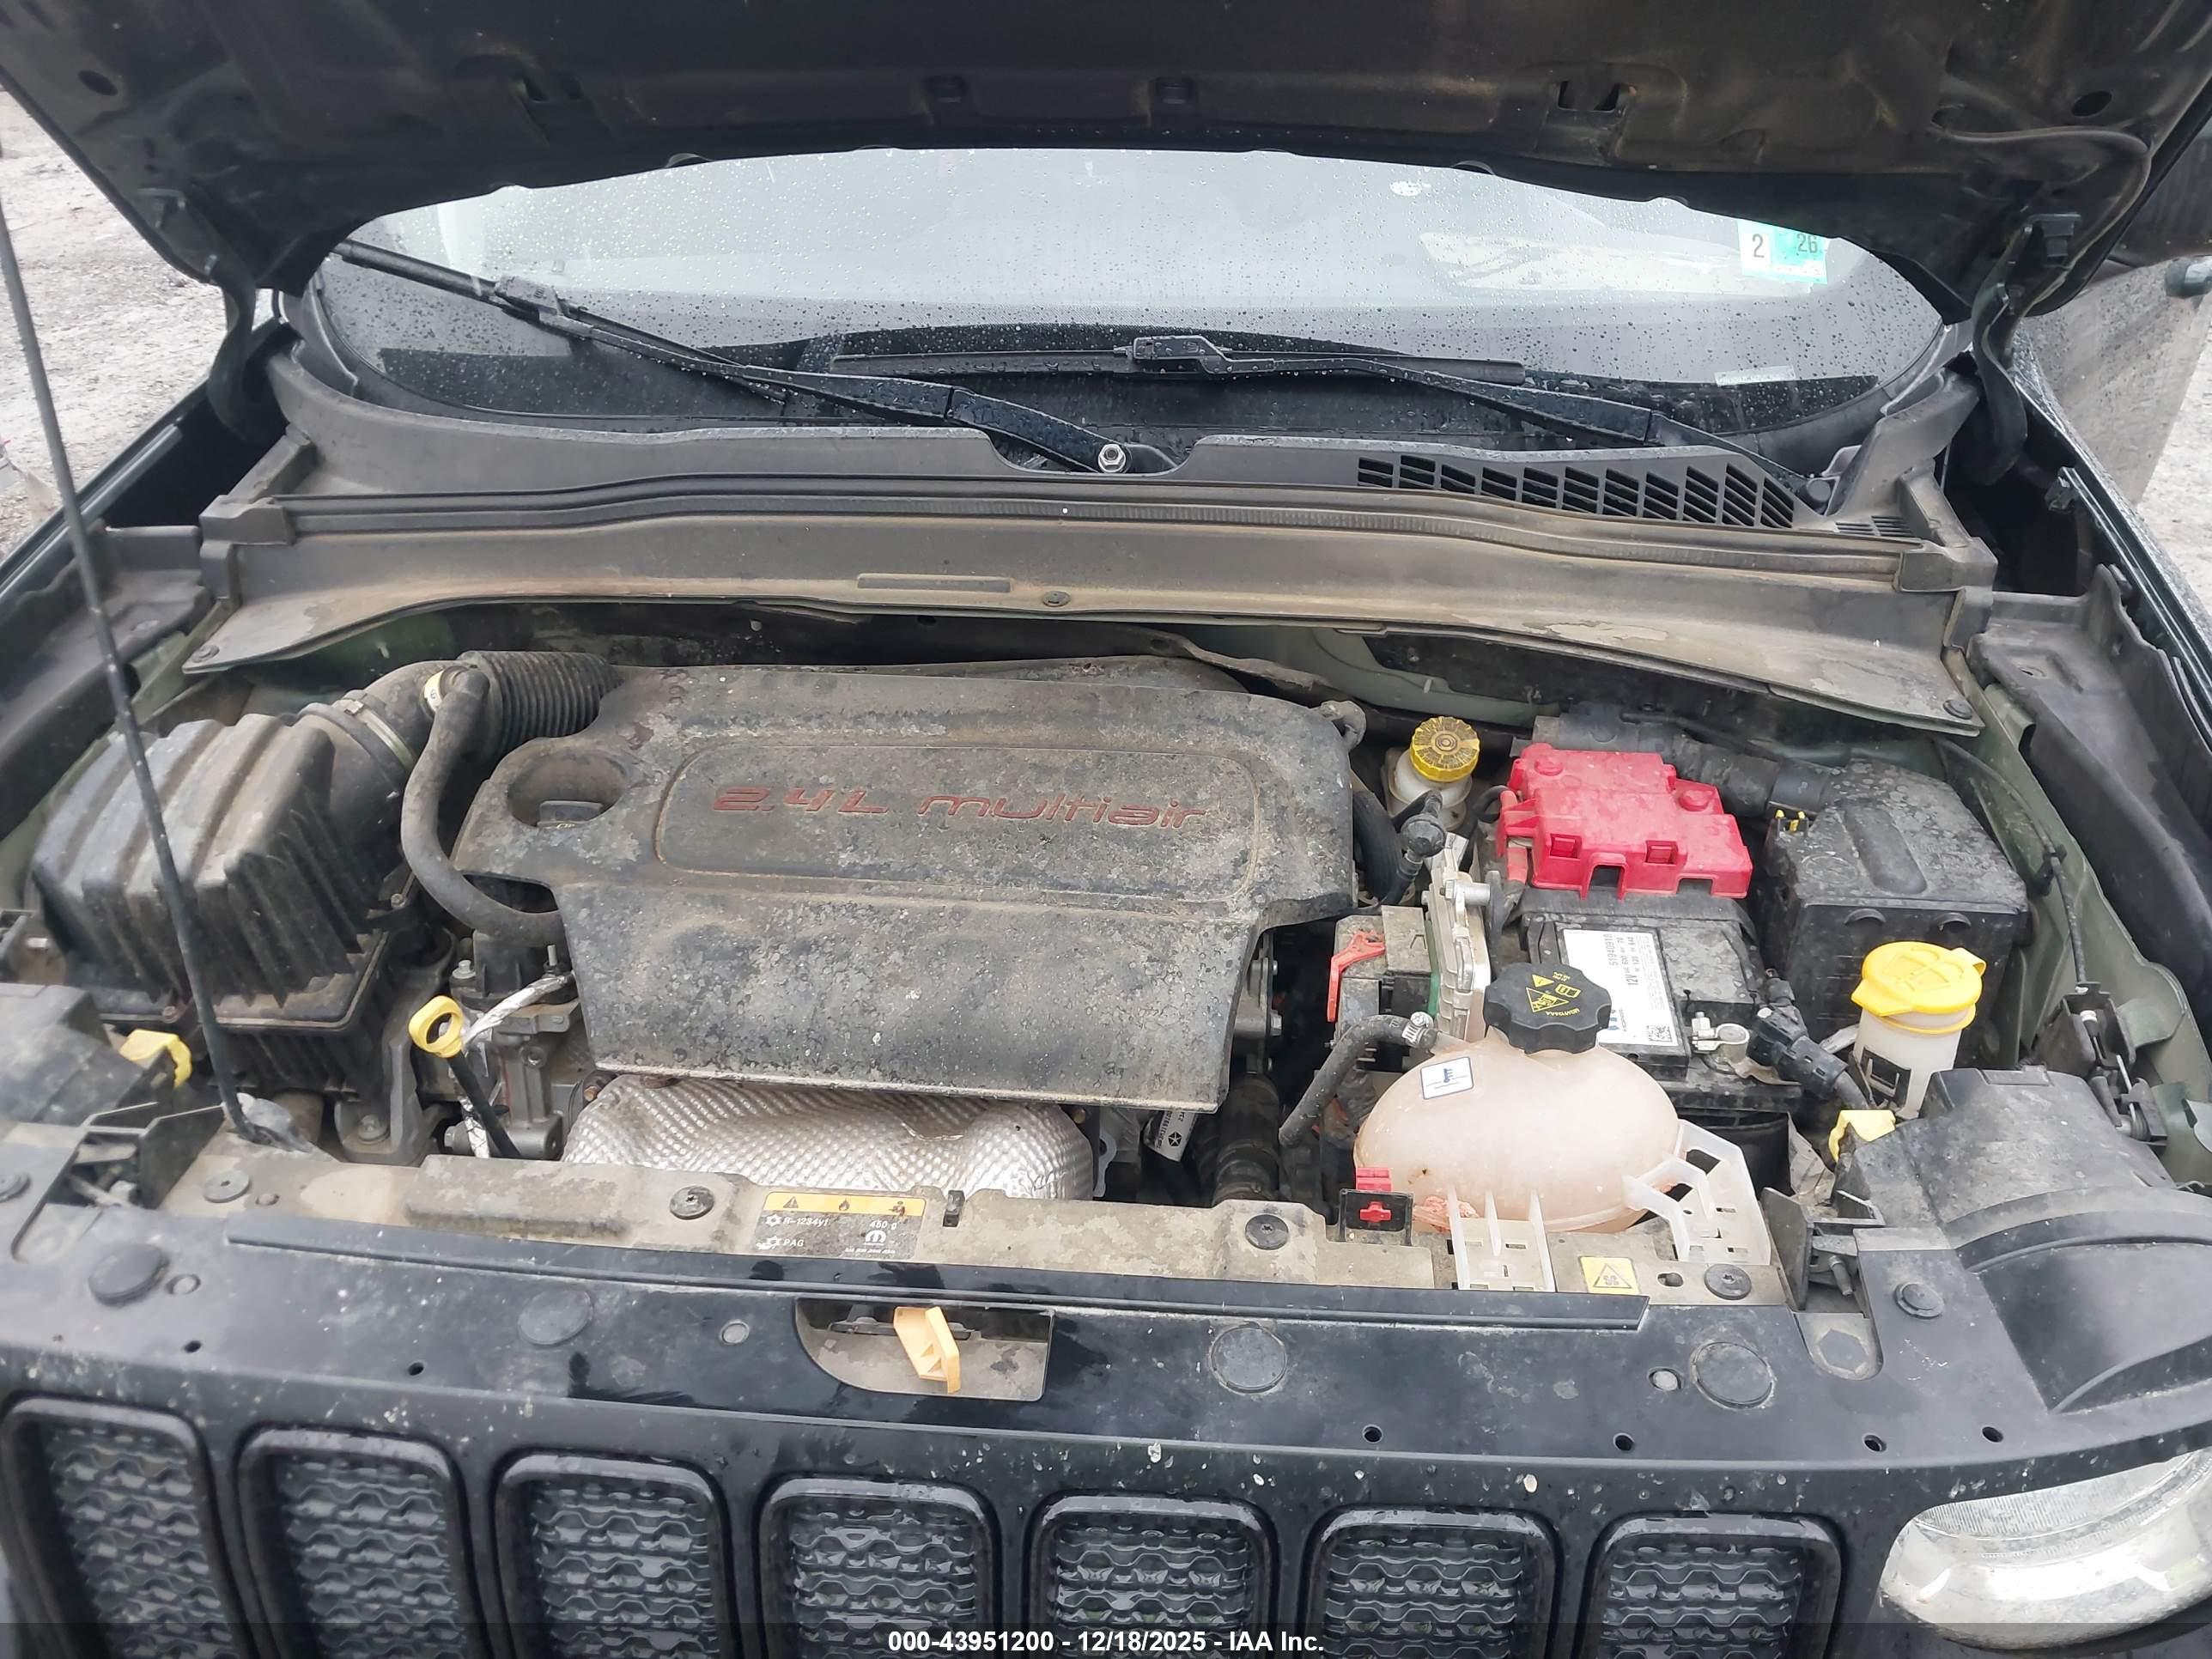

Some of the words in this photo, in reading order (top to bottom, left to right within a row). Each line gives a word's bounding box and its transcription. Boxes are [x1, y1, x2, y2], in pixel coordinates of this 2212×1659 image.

[1752, 233, 1765, 258] 2
[1797, 233, 1818, 253] 26
[713, 787, 888, 814] 2.4L
[917, 792, 1206, 828] multiair
[782, 1238, 805, 1248] PAG
